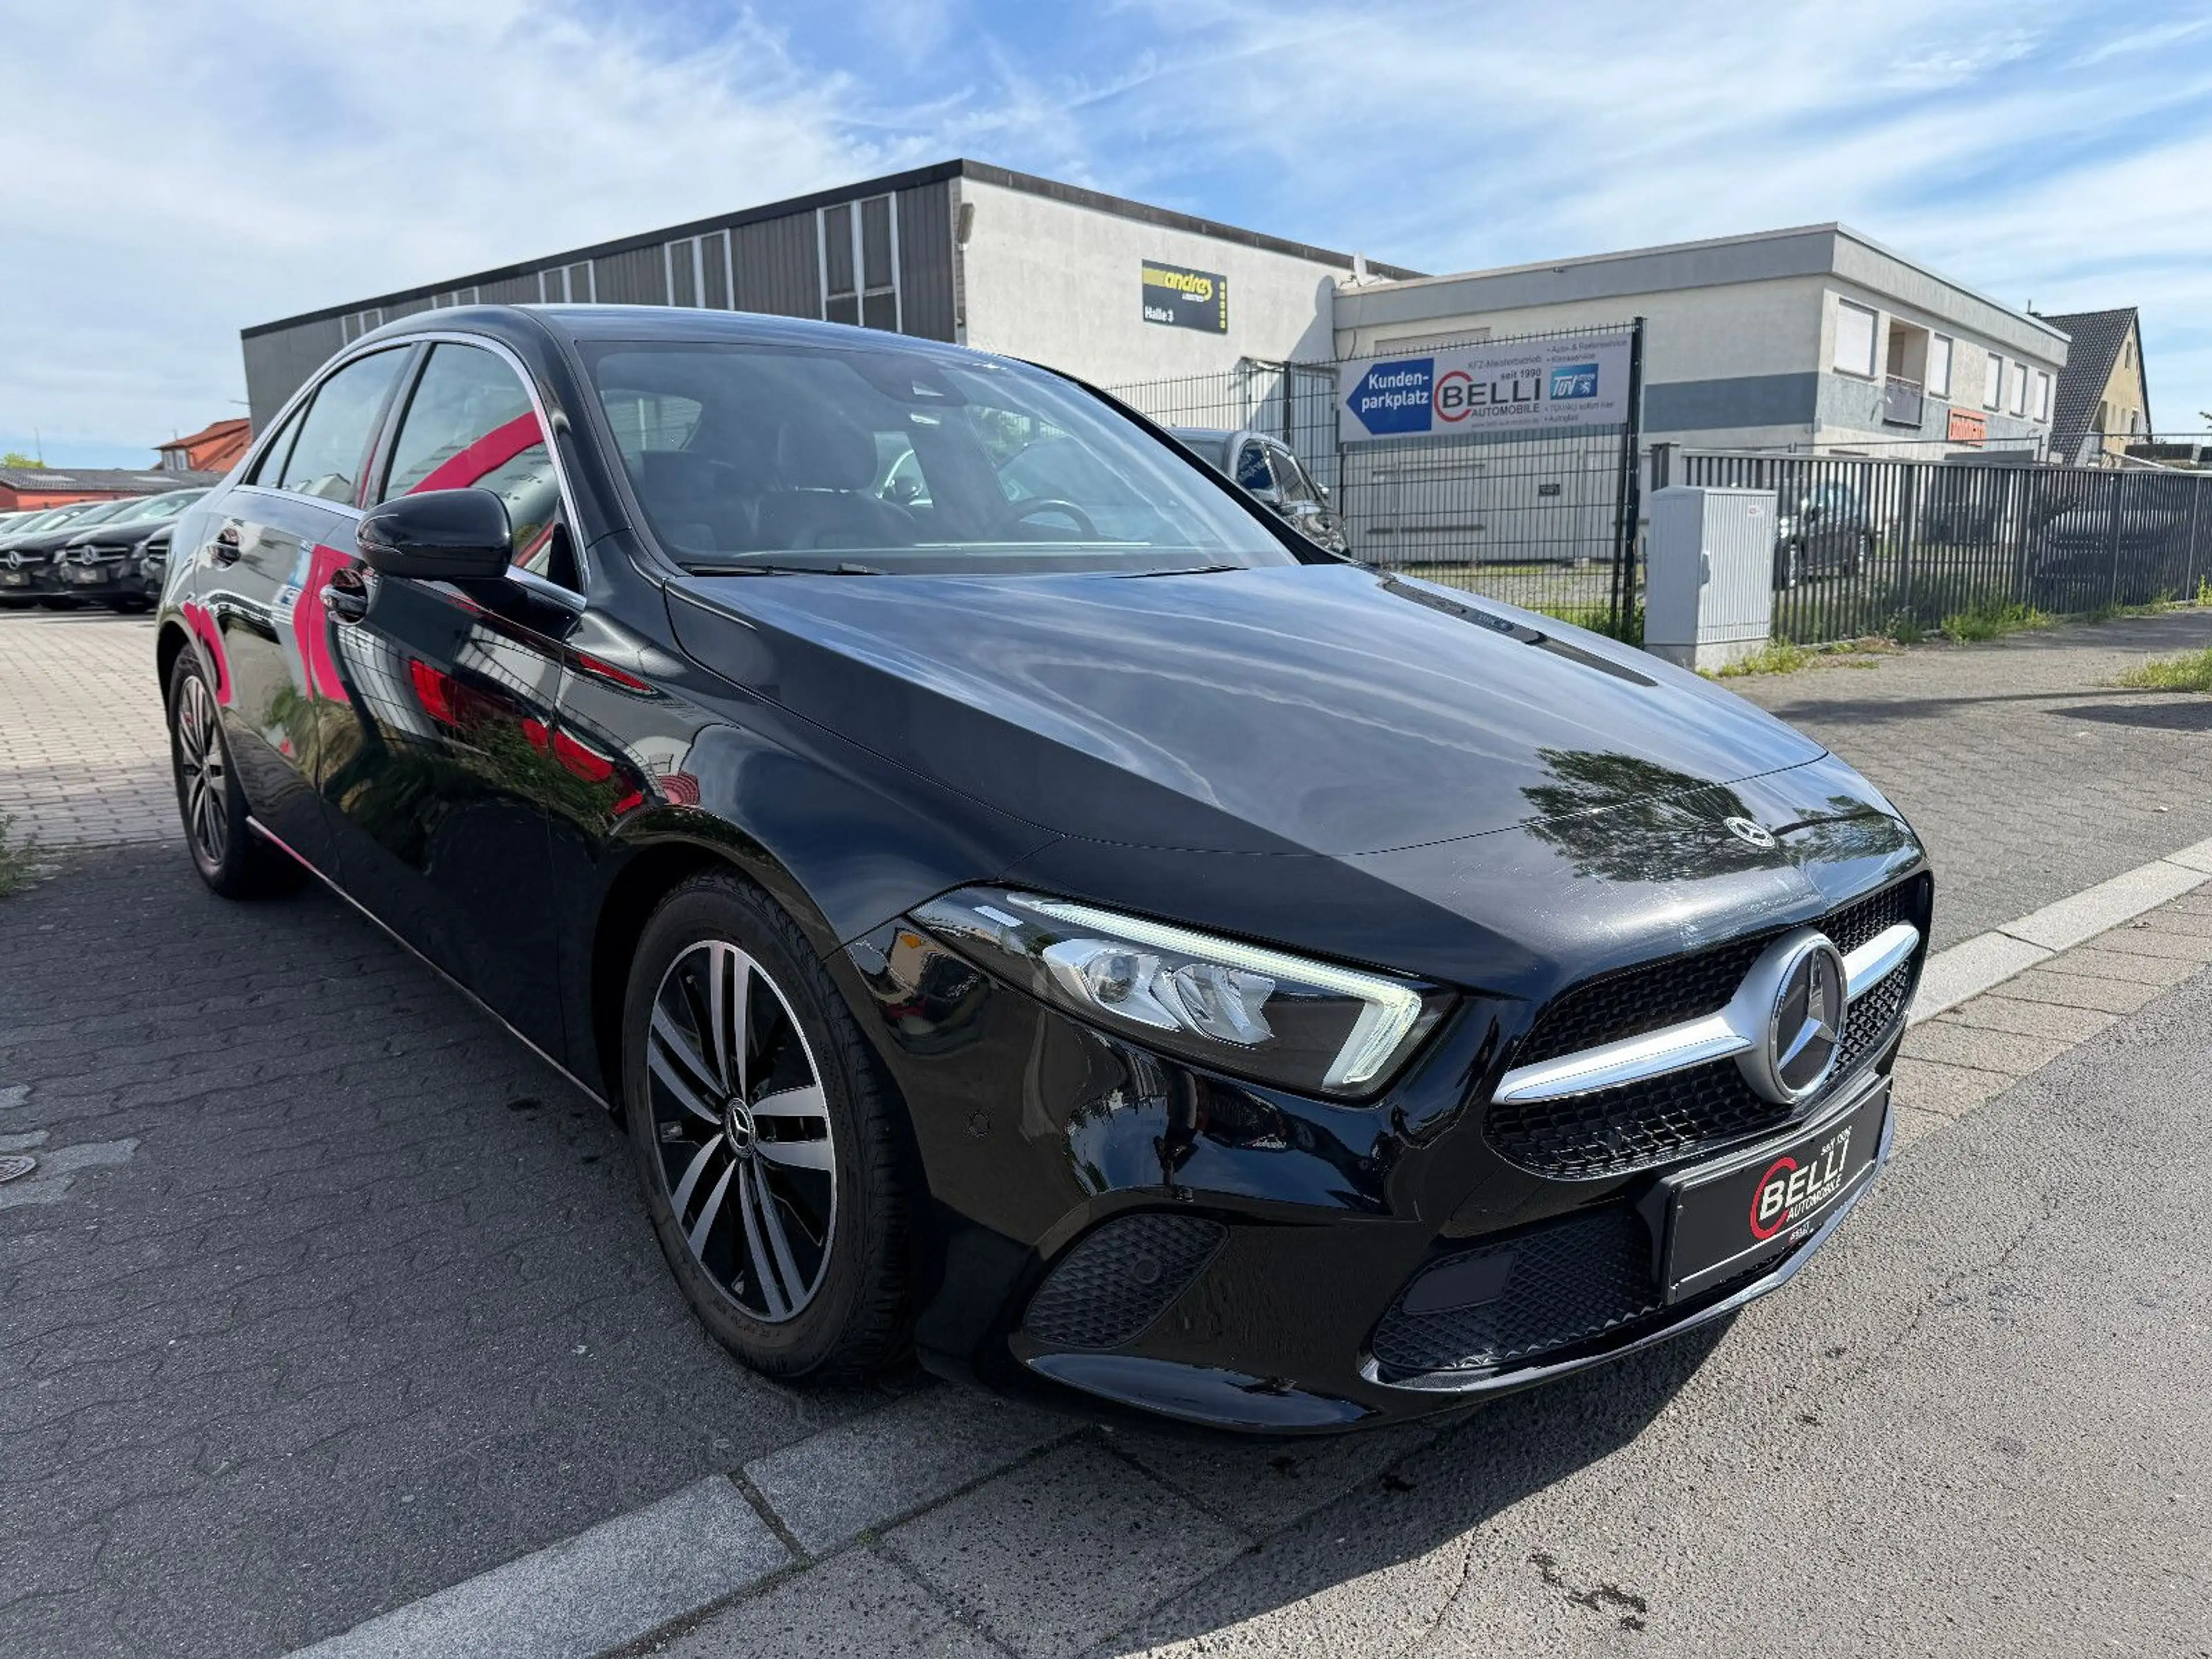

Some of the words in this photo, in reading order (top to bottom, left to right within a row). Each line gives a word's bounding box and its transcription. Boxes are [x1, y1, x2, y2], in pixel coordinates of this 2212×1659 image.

[1145, 306, 1167, 322] Halle
[1168, 309, 1174, 323] 3
[1369, 370, 1429, 389] Kunden-
[1501, 371, 1517, 380] seit
[1520, 368, 1541, 378] 1990
[1442, 378, 1540, 408] BELLI
[1552, 375, 1577, 396] TÜV
[1361, 390, 1429, 413] parkplatz
[1471, 403, 1540, 418] AUTOMOBILE
[1759, 1134, 1849, 1221] BELLI
[1786, 1173, 1842, 1222] AUTOMOBILE
